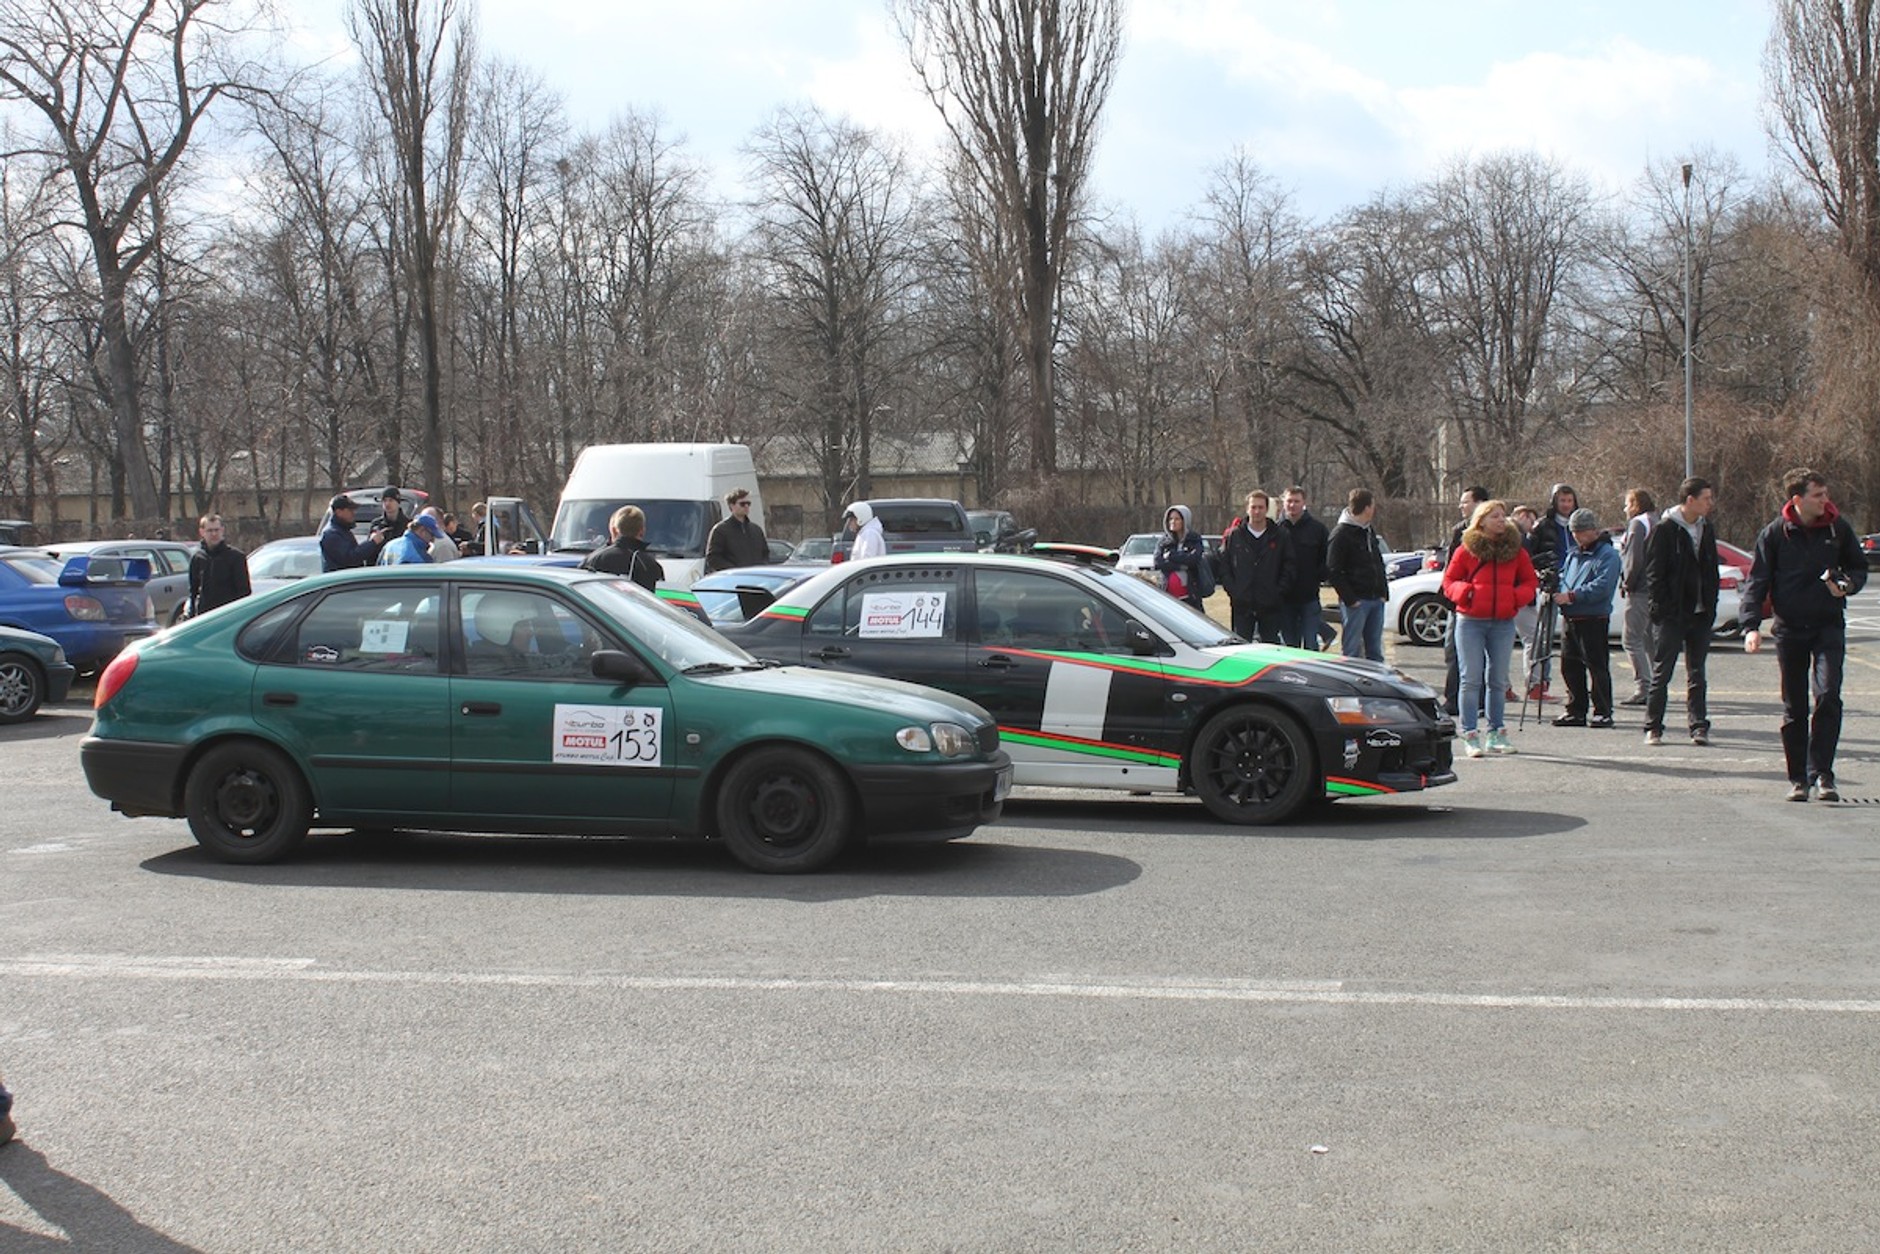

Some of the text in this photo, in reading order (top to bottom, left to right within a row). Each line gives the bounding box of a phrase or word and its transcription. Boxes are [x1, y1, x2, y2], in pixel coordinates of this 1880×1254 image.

[869, 616, 899, 625] MOTUL
[900, 607, 942, 630] 144
[564, 736, 605, 748] MOTUL
[609, 729, 658, 761] 153
